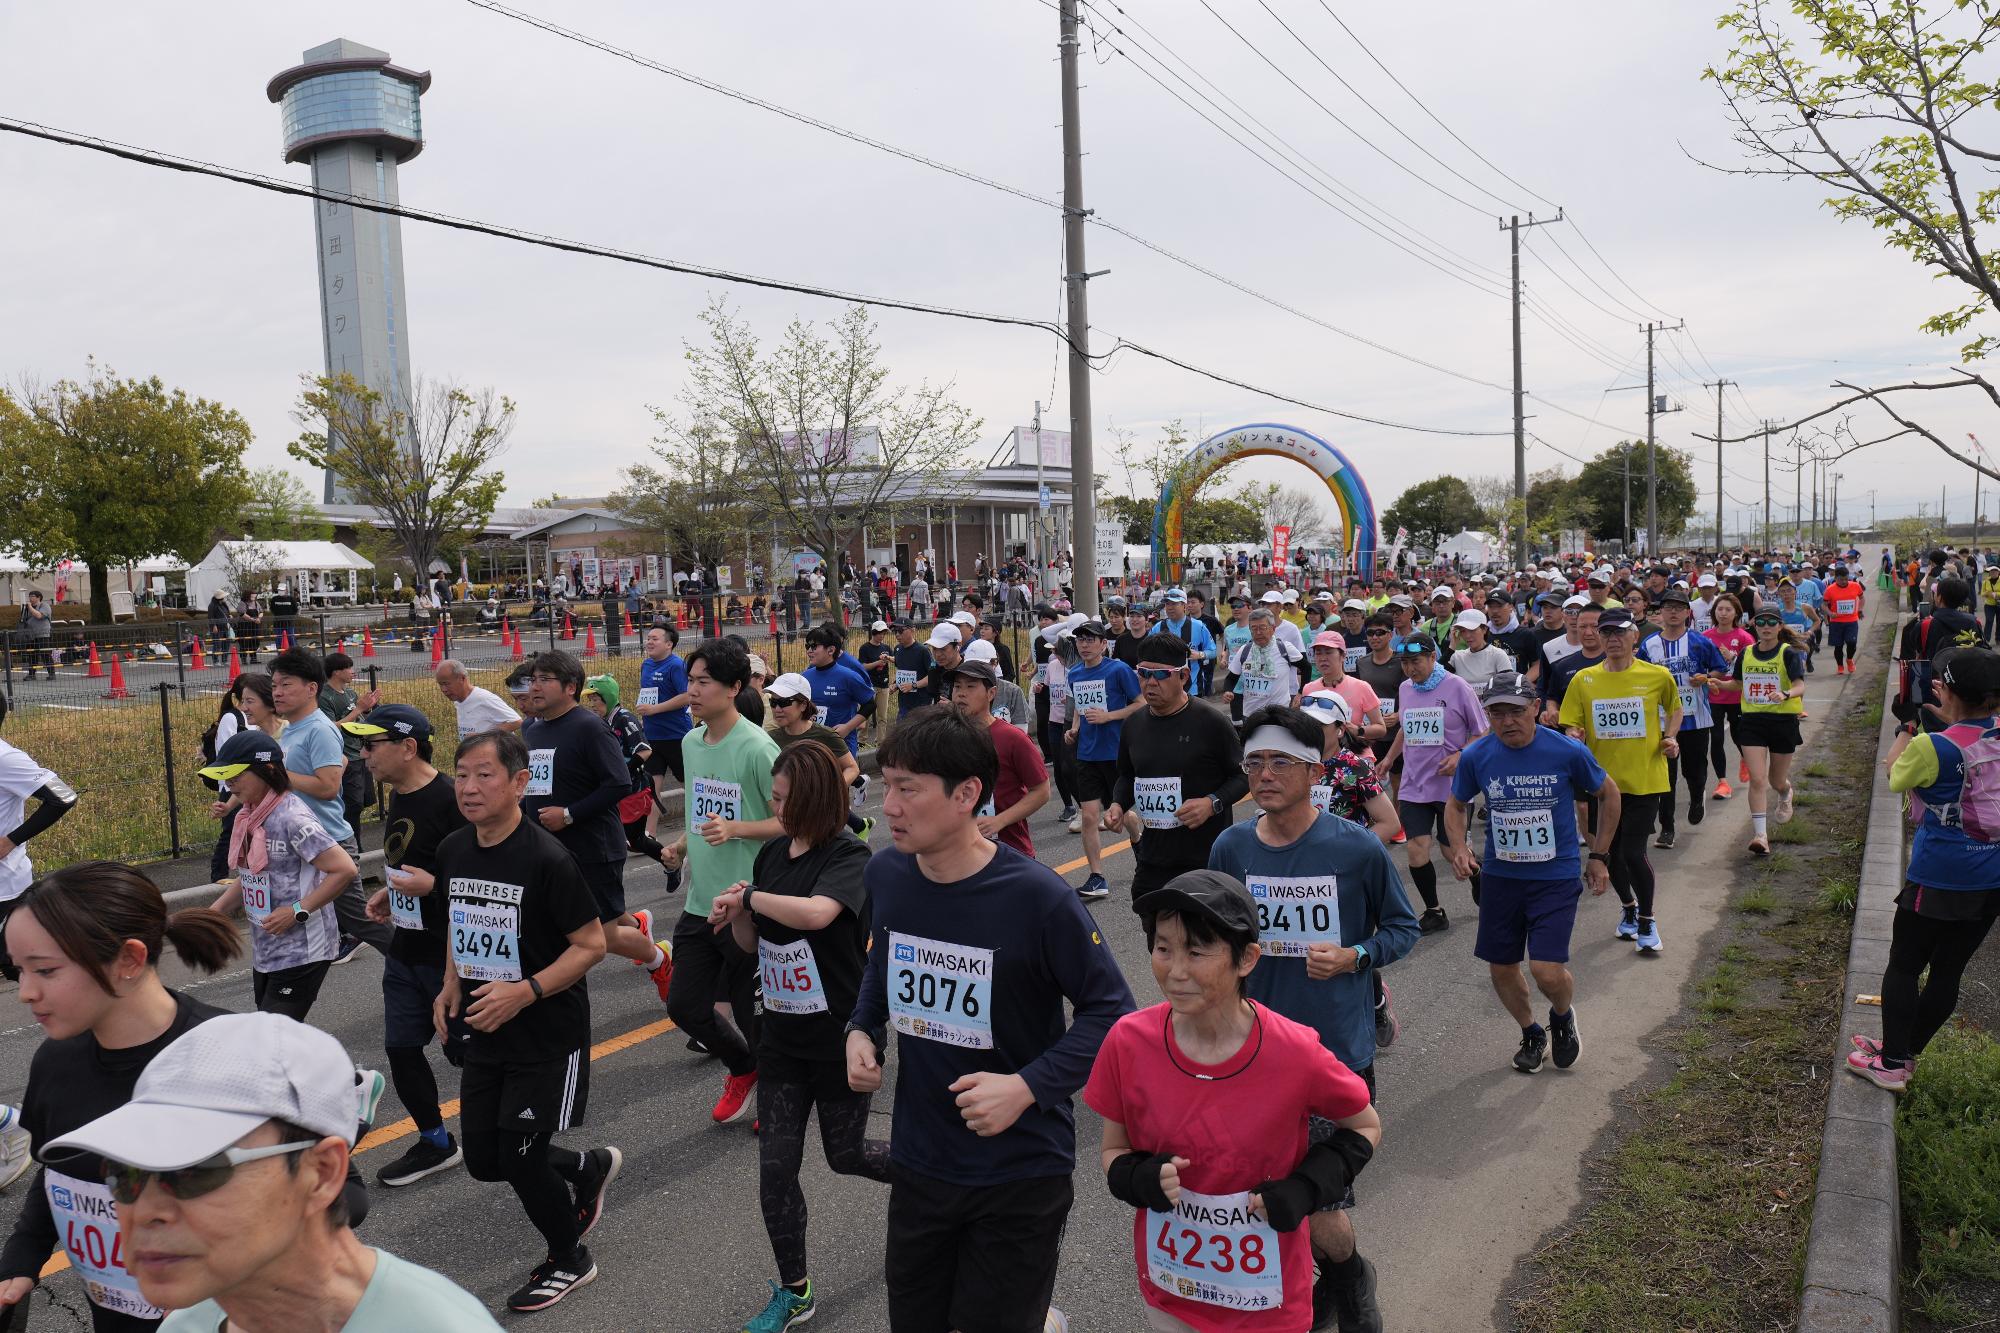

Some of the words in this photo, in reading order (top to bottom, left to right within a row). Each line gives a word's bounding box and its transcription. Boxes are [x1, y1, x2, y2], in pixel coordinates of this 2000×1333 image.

[1245, 679, 1269, 690] 3717
[1749, 683, 1776, 701] 伴走
[1078, 692, 1103, 704] 3245
[1406, 720, 1439, 734] 3796
[1598, 712, 1639, 726] 3809
[1142, 783, 1178, 792] IWASAKI
[1506, 775, 1558, 786] KNIGHTS
[705, 785, 737, 798] IWASAKI
[696, 797, 735, 821] 3025
[1138, 795, 1177, 813] 3443
[1504, 814, 1549, 826] IWASAKI
[1497, 827, 1549, 846] 3713
[450, 881, 519, 900] CONVERSE
[1269, 885, 1332, 898] IWASAKI
[466, 913, 512, 928] IWASAKI
[1257, 904, 1329, 932] 3410
[456, 929, 511, 959] 3494
[766, 948, 808, 964] IWASAKI
[918, 948, 986, 975] IWASAKI
[763, 964, 812, 992] 4145
[898, 969, 979, 1017] 3076
[913, 1024, 981, 1046] 行田市鉄剣マラソン大会
[1157, 1220, 1266, 1274] 4238
[1178, 1283, 1269, 1307] 行田市鉄剣マラソン大会
